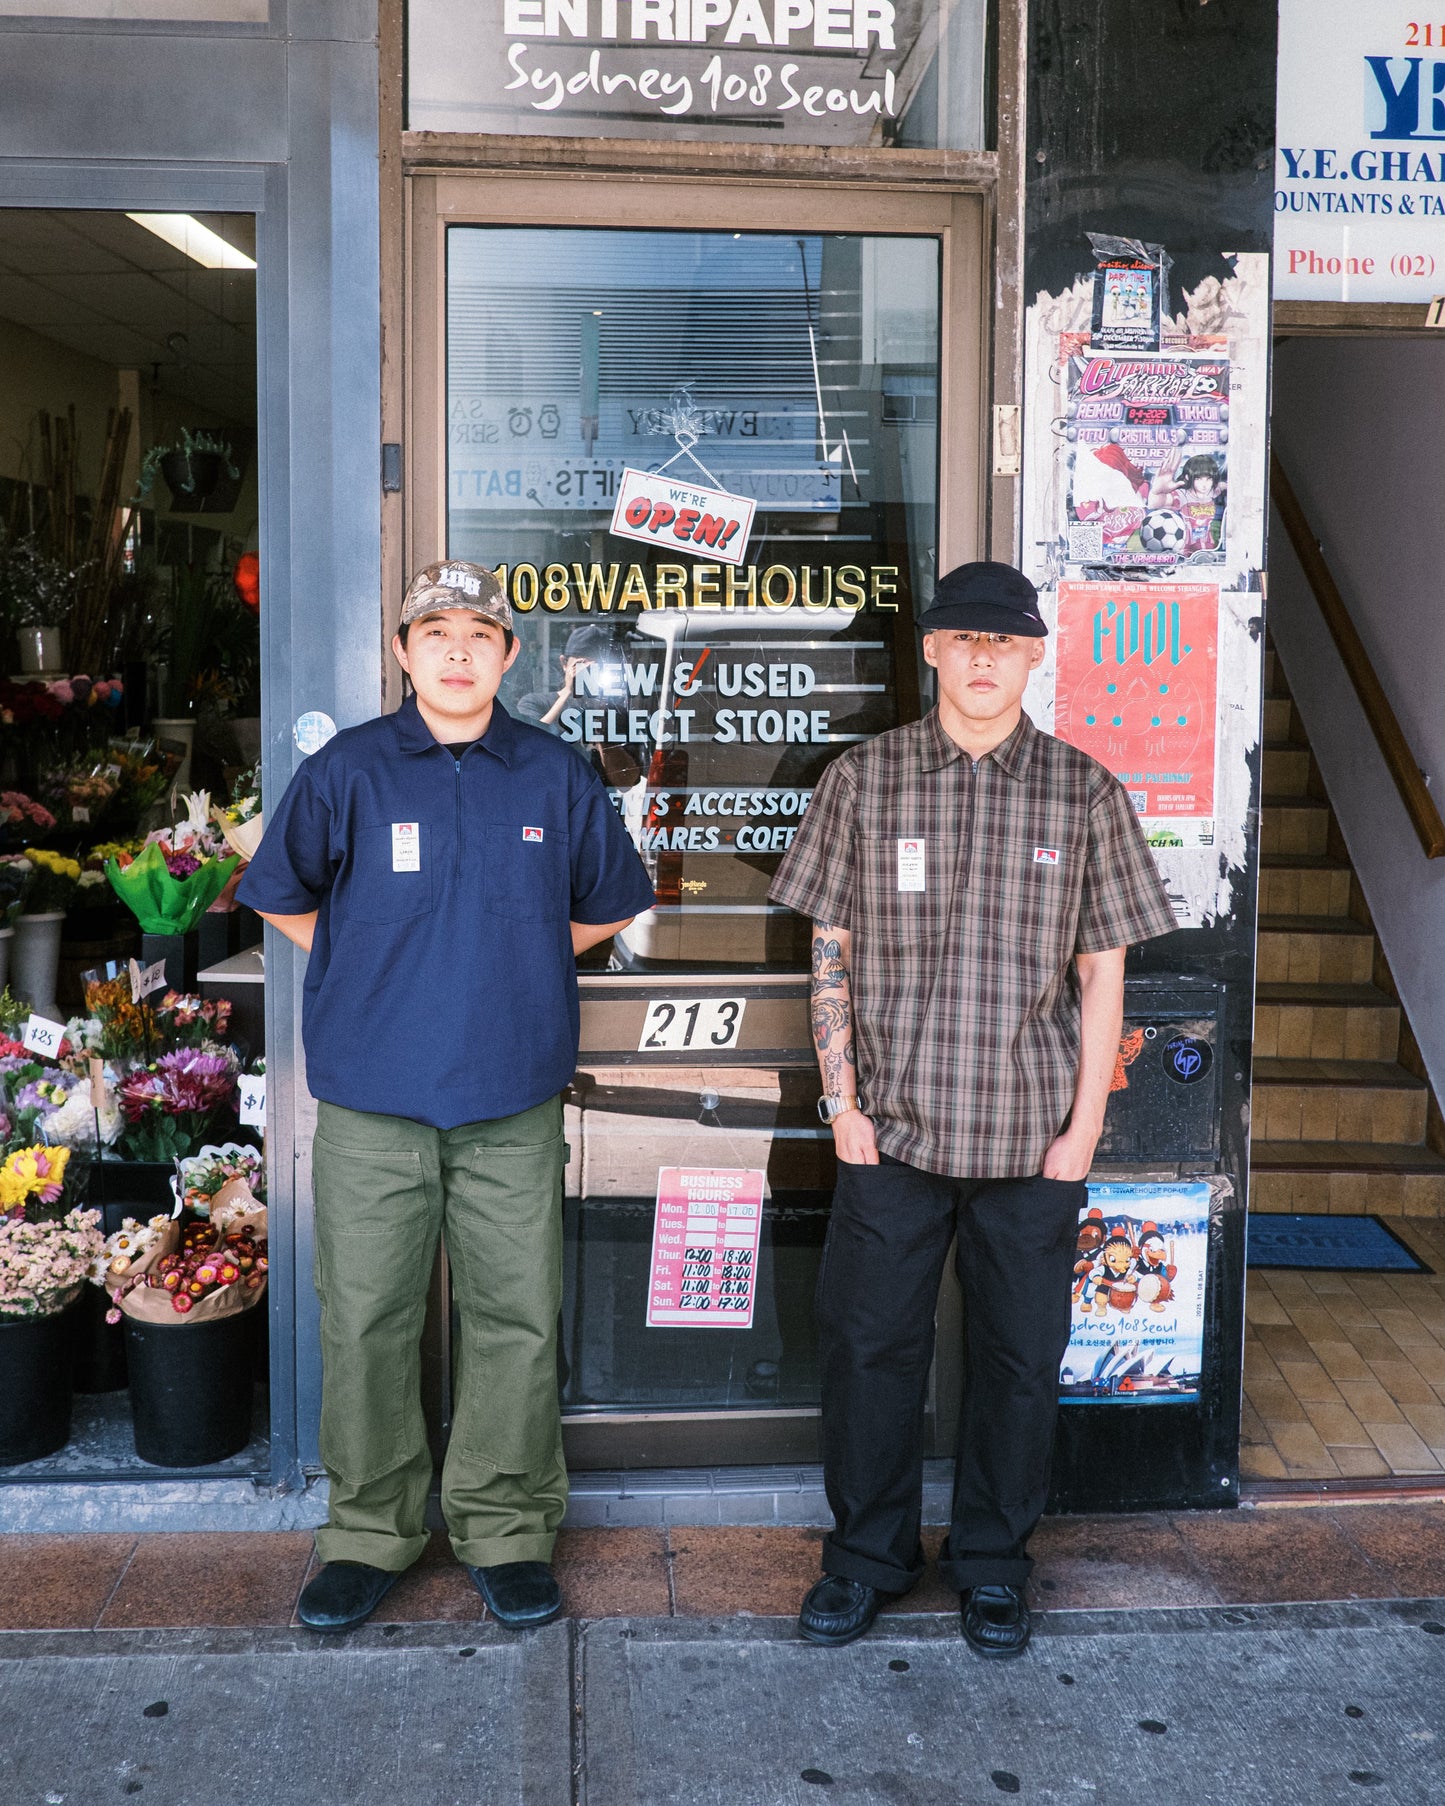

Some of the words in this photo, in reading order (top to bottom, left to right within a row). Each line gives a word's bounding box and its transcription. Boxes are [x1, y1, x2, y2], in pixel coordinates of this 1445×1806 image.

[503, 42, 692, 115] Sydney
[699, 54, 772, 112] 108
[775, 63, 895, 117] Seoul
[1279, 147, 1445, 182] Y.E.GHA
[1398, 194, 1416, 215] &
[1287, 249, 1375, 275] Phone
[1390, 254, 1435, 277] (02)
[1196, 365, 1225, 376] AWAY
[669, 487, 708, 509] WE'RE
[624, 495, 742, 552] OPEN!
[572, 662, 660, 699] NEW
[672, 661, 702, 699] &
[718, 662, 817, 699] USED
[559, 707, 695, 743] SELECT
[713, 707, 831, 743] STORE
[644, 1001, 740, 1048] 213
[31, 1026, 53, 1047] $25
[680, 1175, 743, 1190] BUSINESS
[687, 1188, 735, 1202] HOURS:
[660, 1203, 686, 1214] Mon.
[660, 1218, 686, 1229] Tues.
[659, 1233, 683, 1245] Wed.
[684, 1248, 713, 1263] 12:00
[722, 1249, 752, 1265] 18:00
[655, 1265, 671, 1275] Fri.
[682, 1263, 711, 1278] 11:00
[721, 1265, 752, 1279] 18:00
[654, 1279, 673, 1290] Sat.
[681, 1279, 710, 1293] 11:00
[719, 1280, 749, 1294] 18:00
[652, 1296, 675, 1306] Sun.
[679, 1294, 710, 1309] 12:00
[717, 1296, 750, 1310] 17:00
[1118, 1316, 1139, 1334] 108
[1141, 1318, 1178, 1334] Seoul
